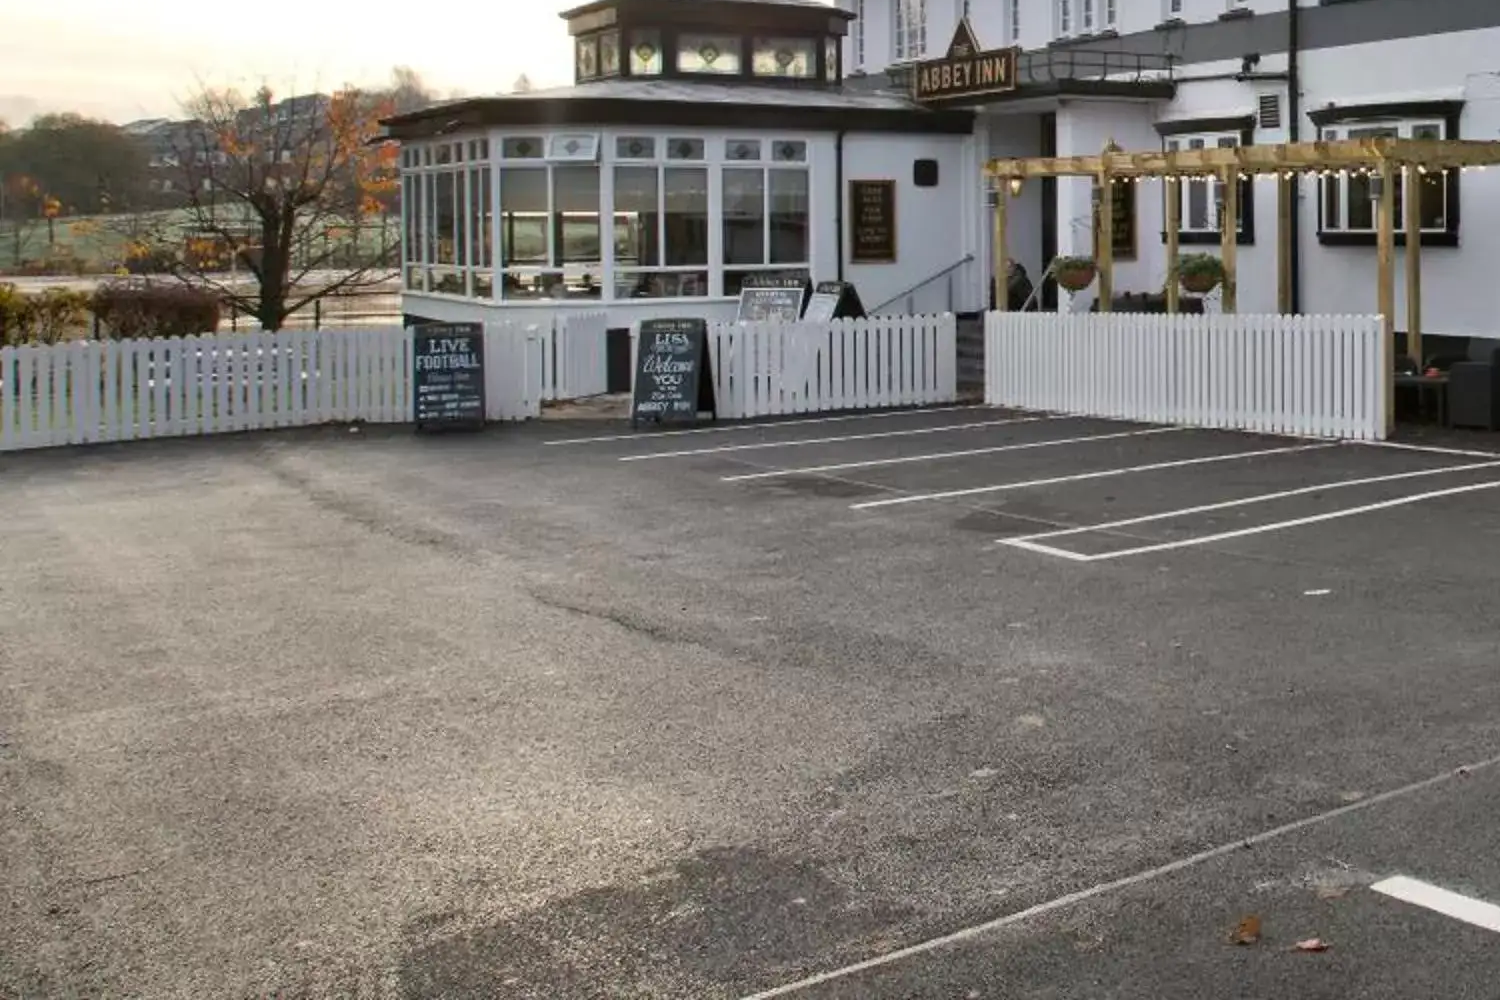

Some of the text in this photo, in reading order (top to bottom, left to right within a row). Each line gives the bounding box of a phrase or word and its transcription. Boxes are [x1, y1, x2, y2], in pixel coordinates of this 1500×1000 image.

[921, 57, 1007, 92] ABBEY INN
[428, 338, 472, 353] LIVE
[415, 353, 481, 371] FOOTBALL
